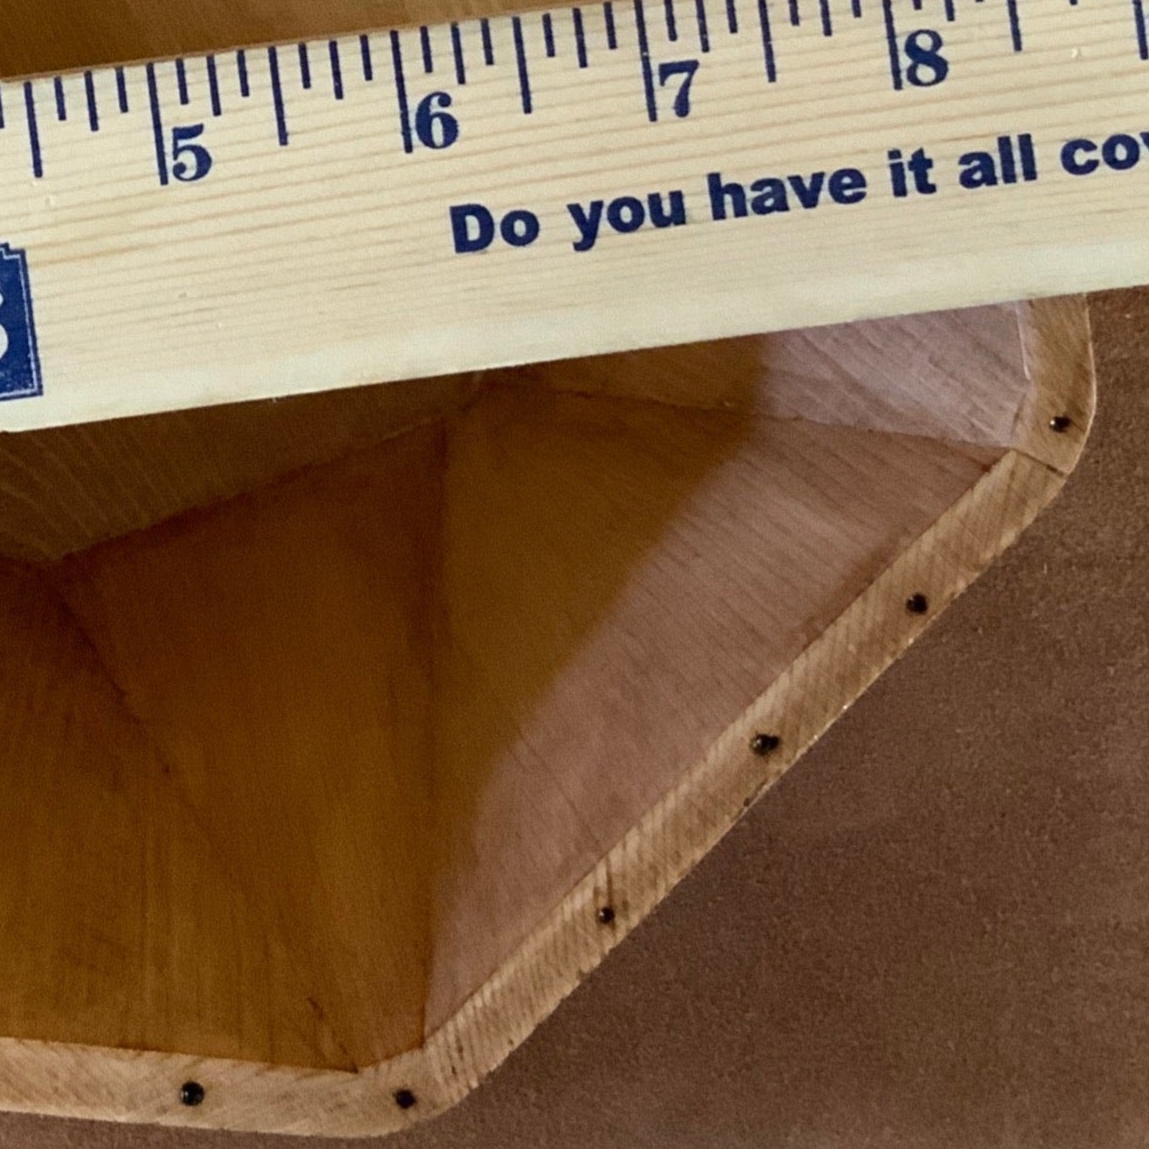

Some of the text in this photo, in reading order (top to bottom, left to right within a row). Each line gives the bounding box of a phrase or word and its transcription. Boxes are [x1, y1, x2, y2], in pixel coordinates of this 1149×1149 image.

[170, 124, 214, 182] 5
[414, 91, 460, 150] 6
[658, 59, 700, 118] 7
[903, 29, 950, 87] 8
[449, 131, 1149, 254] Do you have it all co
